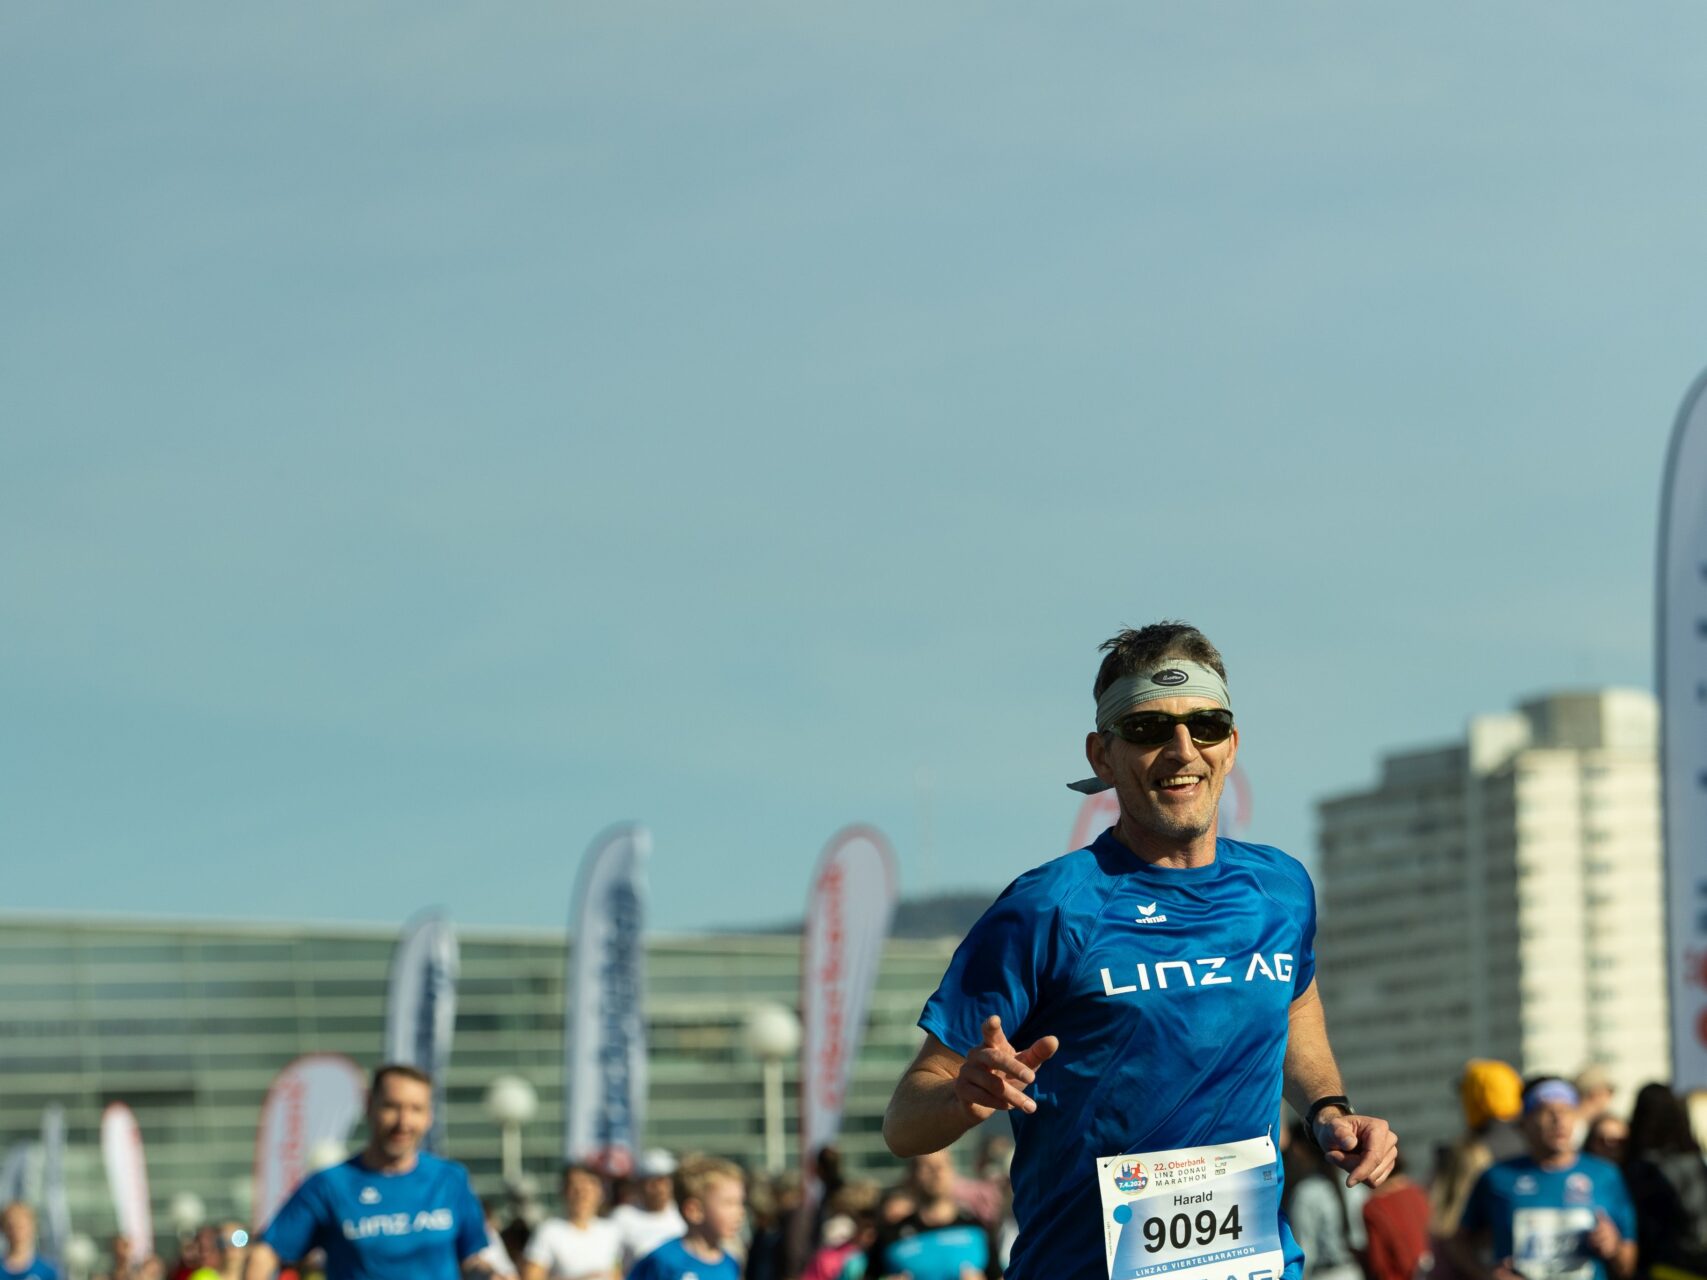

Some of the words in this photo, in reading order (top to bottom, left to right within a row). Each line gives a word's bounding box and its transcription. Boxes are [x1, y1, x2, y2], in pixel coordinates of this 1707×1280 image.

[1135, 914, 1167, 924] erima
[1245, 953, 1294, 983] AG
[1154, 1163, 1167, 1172] 22.
[1168, 1157, 1206, 1170] Oberbank
[1154, 1171, 1174, 1179] LINZ
[1178, 1166, 1207, 1177] DONAU
[1155, 1174, 1207, 1187] MARATHON
[1173, 1190, 1213, 1206] Harald
[1142, 1204, 1243, 1253] 9094
[1135, 1265, 1168, 1277] LINZAG
[1171, 1248, 1256, 1269] VIERTELMARATHON
